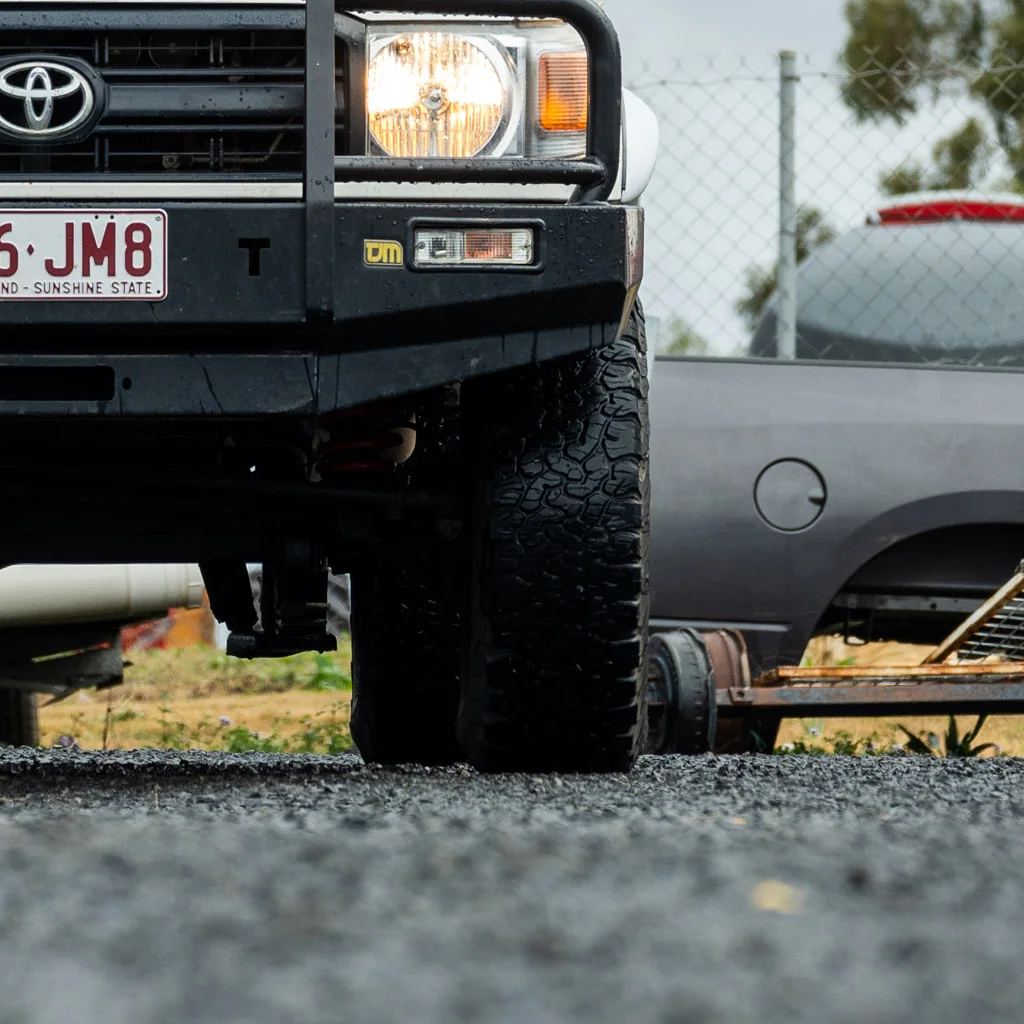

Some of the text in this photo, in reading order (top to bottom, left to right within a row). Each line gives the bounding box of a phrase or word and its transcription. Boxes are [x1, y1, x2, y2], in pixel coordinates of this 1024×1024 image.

[44, 222, 152, 278] JM8
[34, 281, 103, 295] SUNSHINE
[111, 281, 152, 295] STATE
